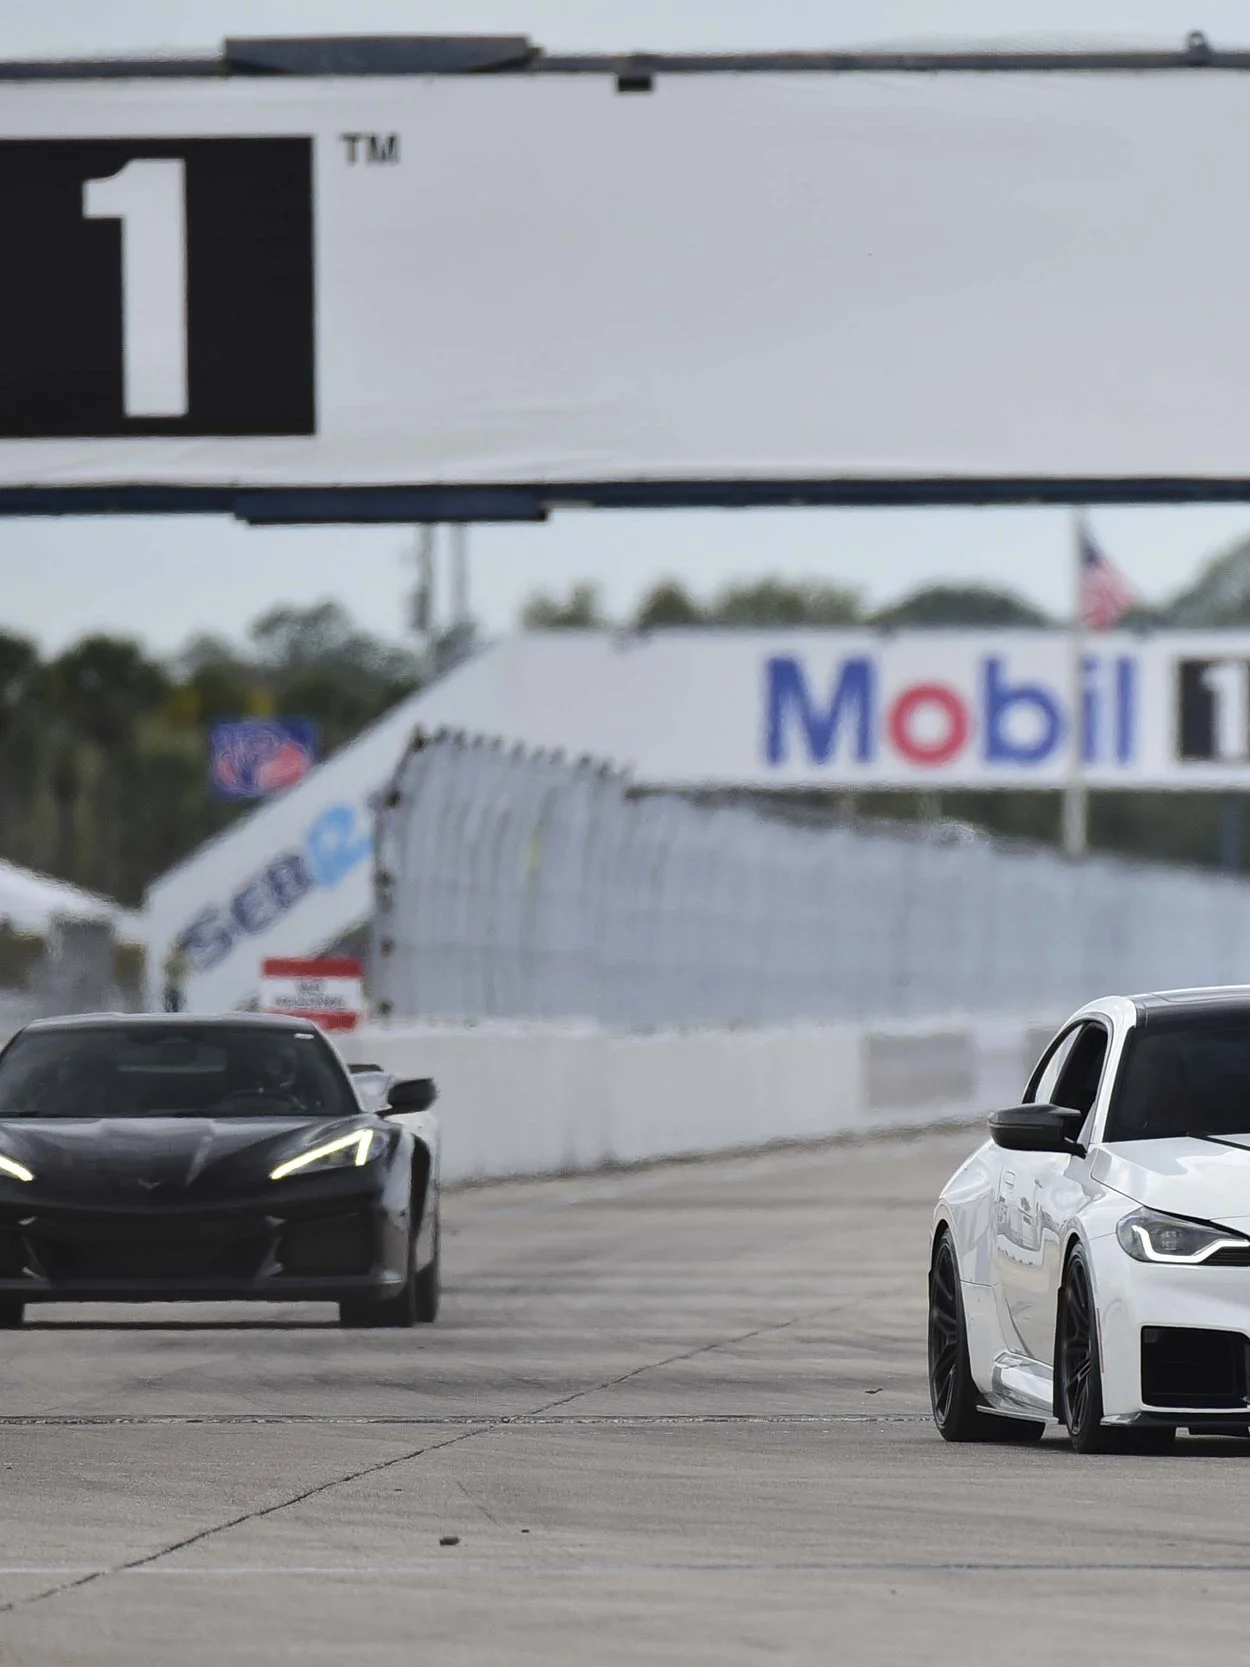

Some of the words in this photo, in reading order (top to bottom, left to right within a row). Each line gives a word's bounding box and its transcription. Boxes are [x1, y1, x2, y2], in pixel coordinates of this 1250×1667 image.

[82, 158, 188, 417] 1
[339, 133, 400, 166] TM
[763, 655, 1135, 766] Mobil
